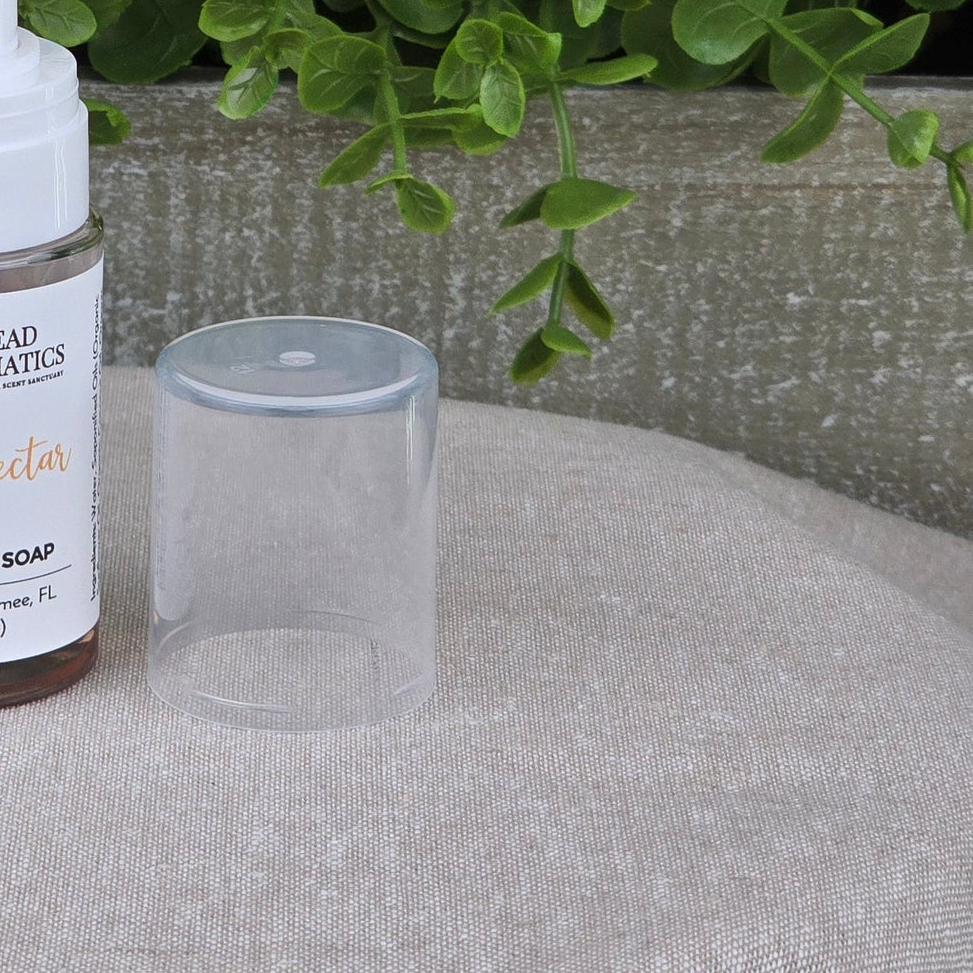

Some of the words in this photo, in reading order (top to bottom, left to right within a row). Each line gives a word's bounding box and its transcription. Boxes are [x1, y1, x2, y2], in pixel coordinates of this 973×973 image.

[2, 379, 26, 389] SCENT
[27, 369, 64, 385] SANCTUARY
[1, 542, 55, 569] SOAP
[39, 585, 57, 603] FL
